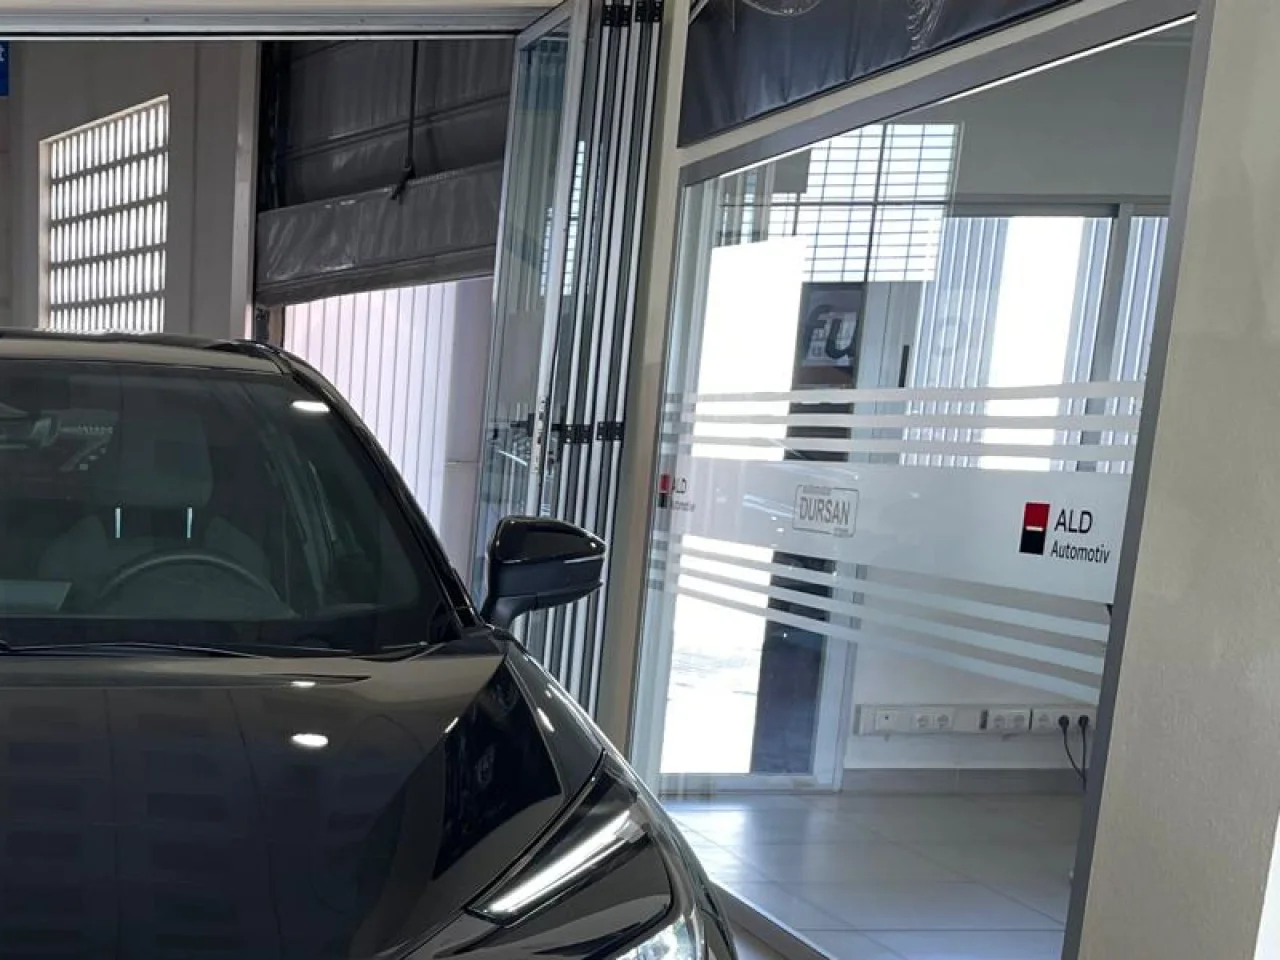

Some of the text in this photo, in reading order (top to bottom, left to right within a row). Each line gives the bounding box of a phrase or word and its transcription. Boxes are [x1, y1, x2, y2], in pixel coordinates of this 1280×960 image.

[799, 496, 850, 525] DURSAN
[1053, 508, 1093, 533] ALD
[1050, 540, 1111, 563] Automotiv
